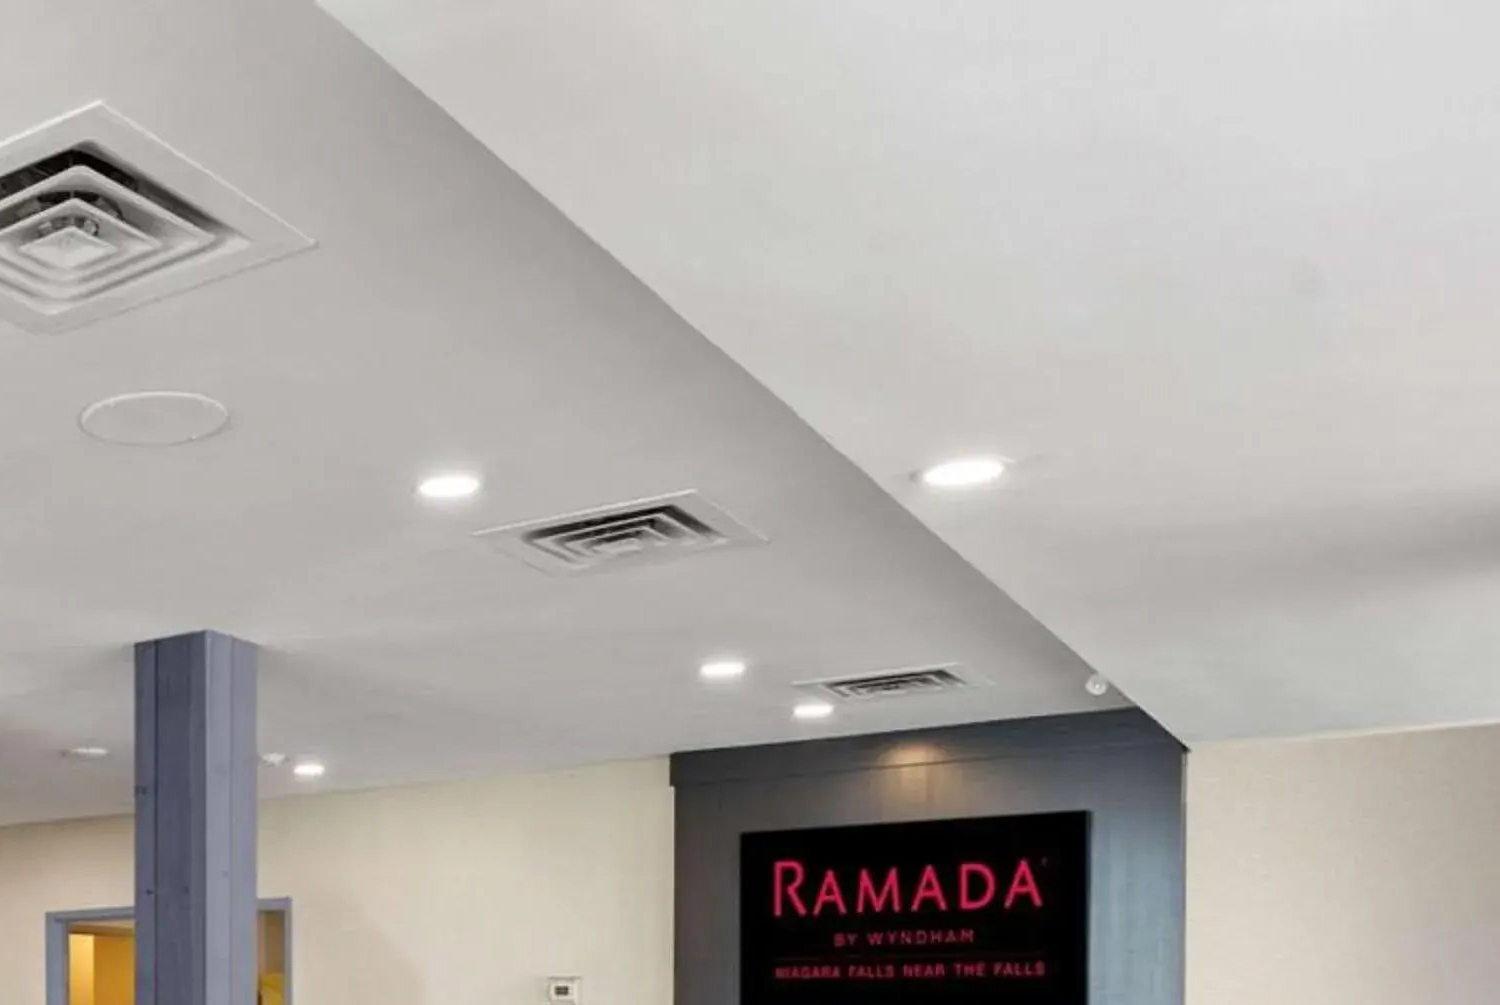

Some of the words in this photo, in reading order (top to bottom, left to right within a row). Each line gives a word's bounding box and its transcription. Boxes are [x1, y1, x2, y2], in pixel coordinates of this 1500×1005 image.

[773, 858, 1044, 917] RAMADA
[833, 932, 858, 947] BY
[866, 929, 974, 946] WYNDHAM
[775, 964, 840, 979] NIAGARA
[848, 963, 895, 979] FALLS
[902, 962, 945, 978] NEAR
[953, 961, 985, 977] THE
[993, 959, 1045, 976] FALLS
